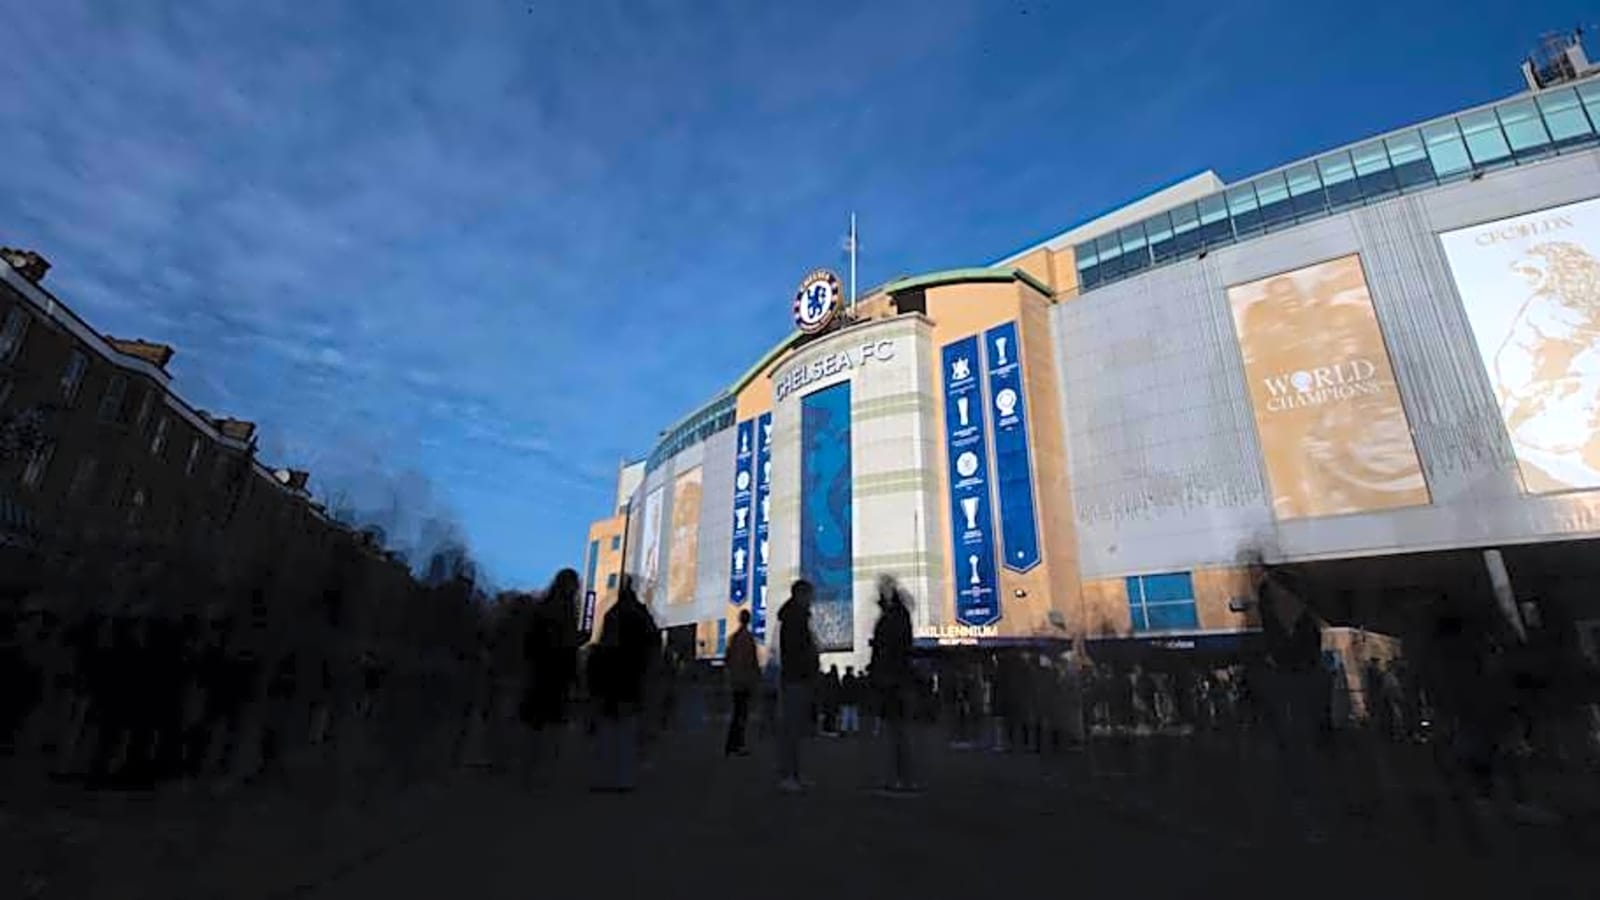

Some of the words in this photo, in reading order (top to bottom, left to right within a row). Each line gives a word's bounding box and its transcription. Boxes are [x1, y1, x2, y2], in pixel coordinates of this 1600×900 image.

[775, 351, 853, 402] CHELSEA
[859, 340, 896, 366] FC
[1264, 359, 1375, 397] WORLD
[1266, 380, 1382, 412] CHAMPIONS
[917, 625, 999, 637] MILLENNIUM
